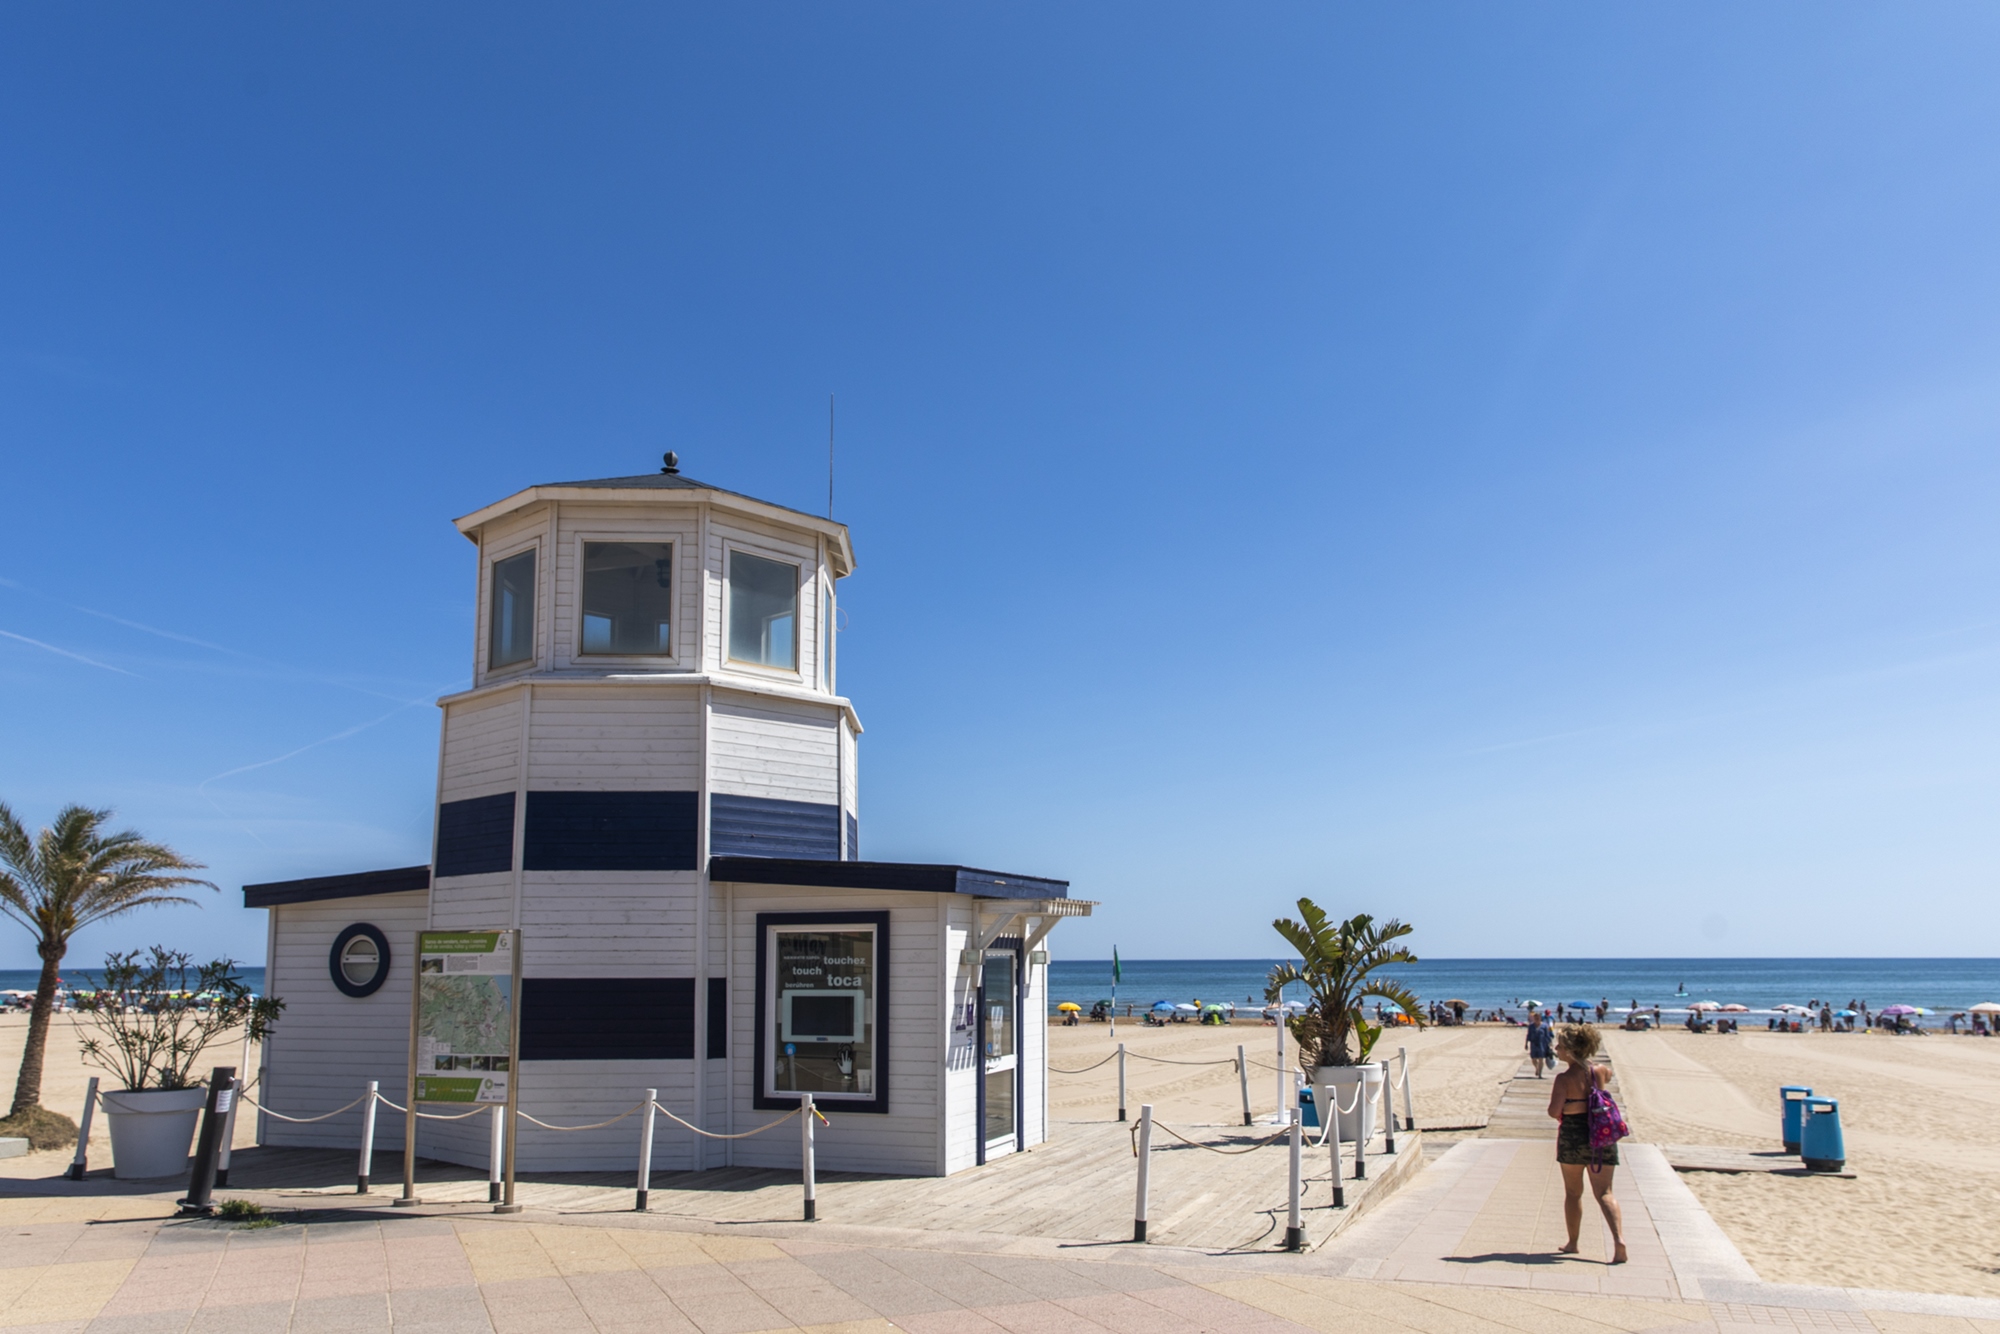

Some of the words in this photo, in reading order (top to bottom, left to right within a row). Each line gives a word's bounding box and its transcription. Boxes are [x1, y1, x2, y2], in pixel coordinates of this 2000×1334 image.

[823, 956, 866, 965] touchez
[792, 966, 822, 975] touch
[827, 974, 863, 987] toca
